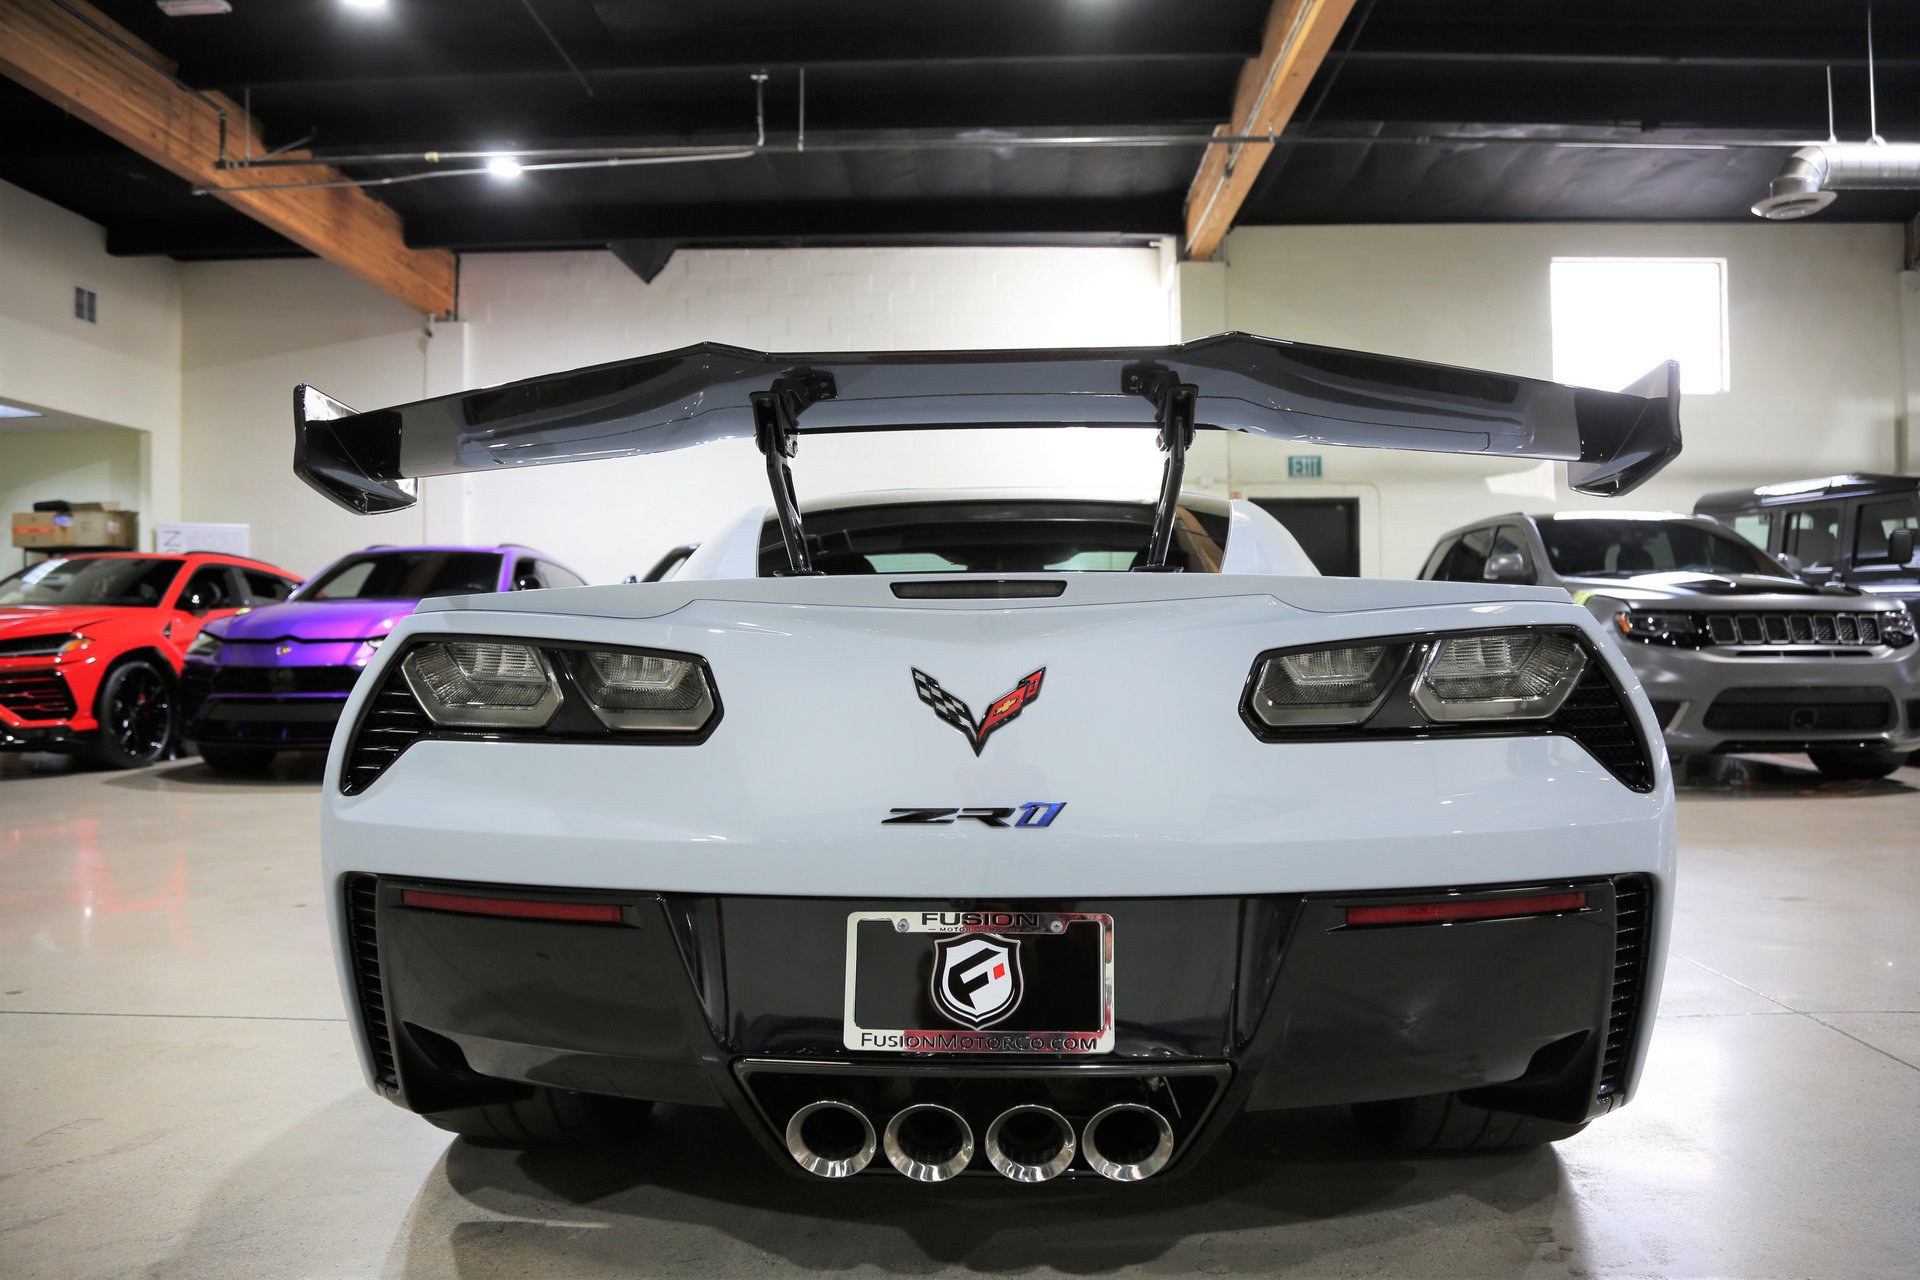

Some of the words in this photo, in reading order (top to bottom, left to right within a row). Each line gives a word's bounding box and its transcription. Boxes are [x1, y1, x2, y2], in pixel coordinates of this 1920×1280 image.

[1293, 457, 1318, 476] EXIT
[880, 801, 1067, 828] ZR1
[921, 912, 1040, 927] FUSION
